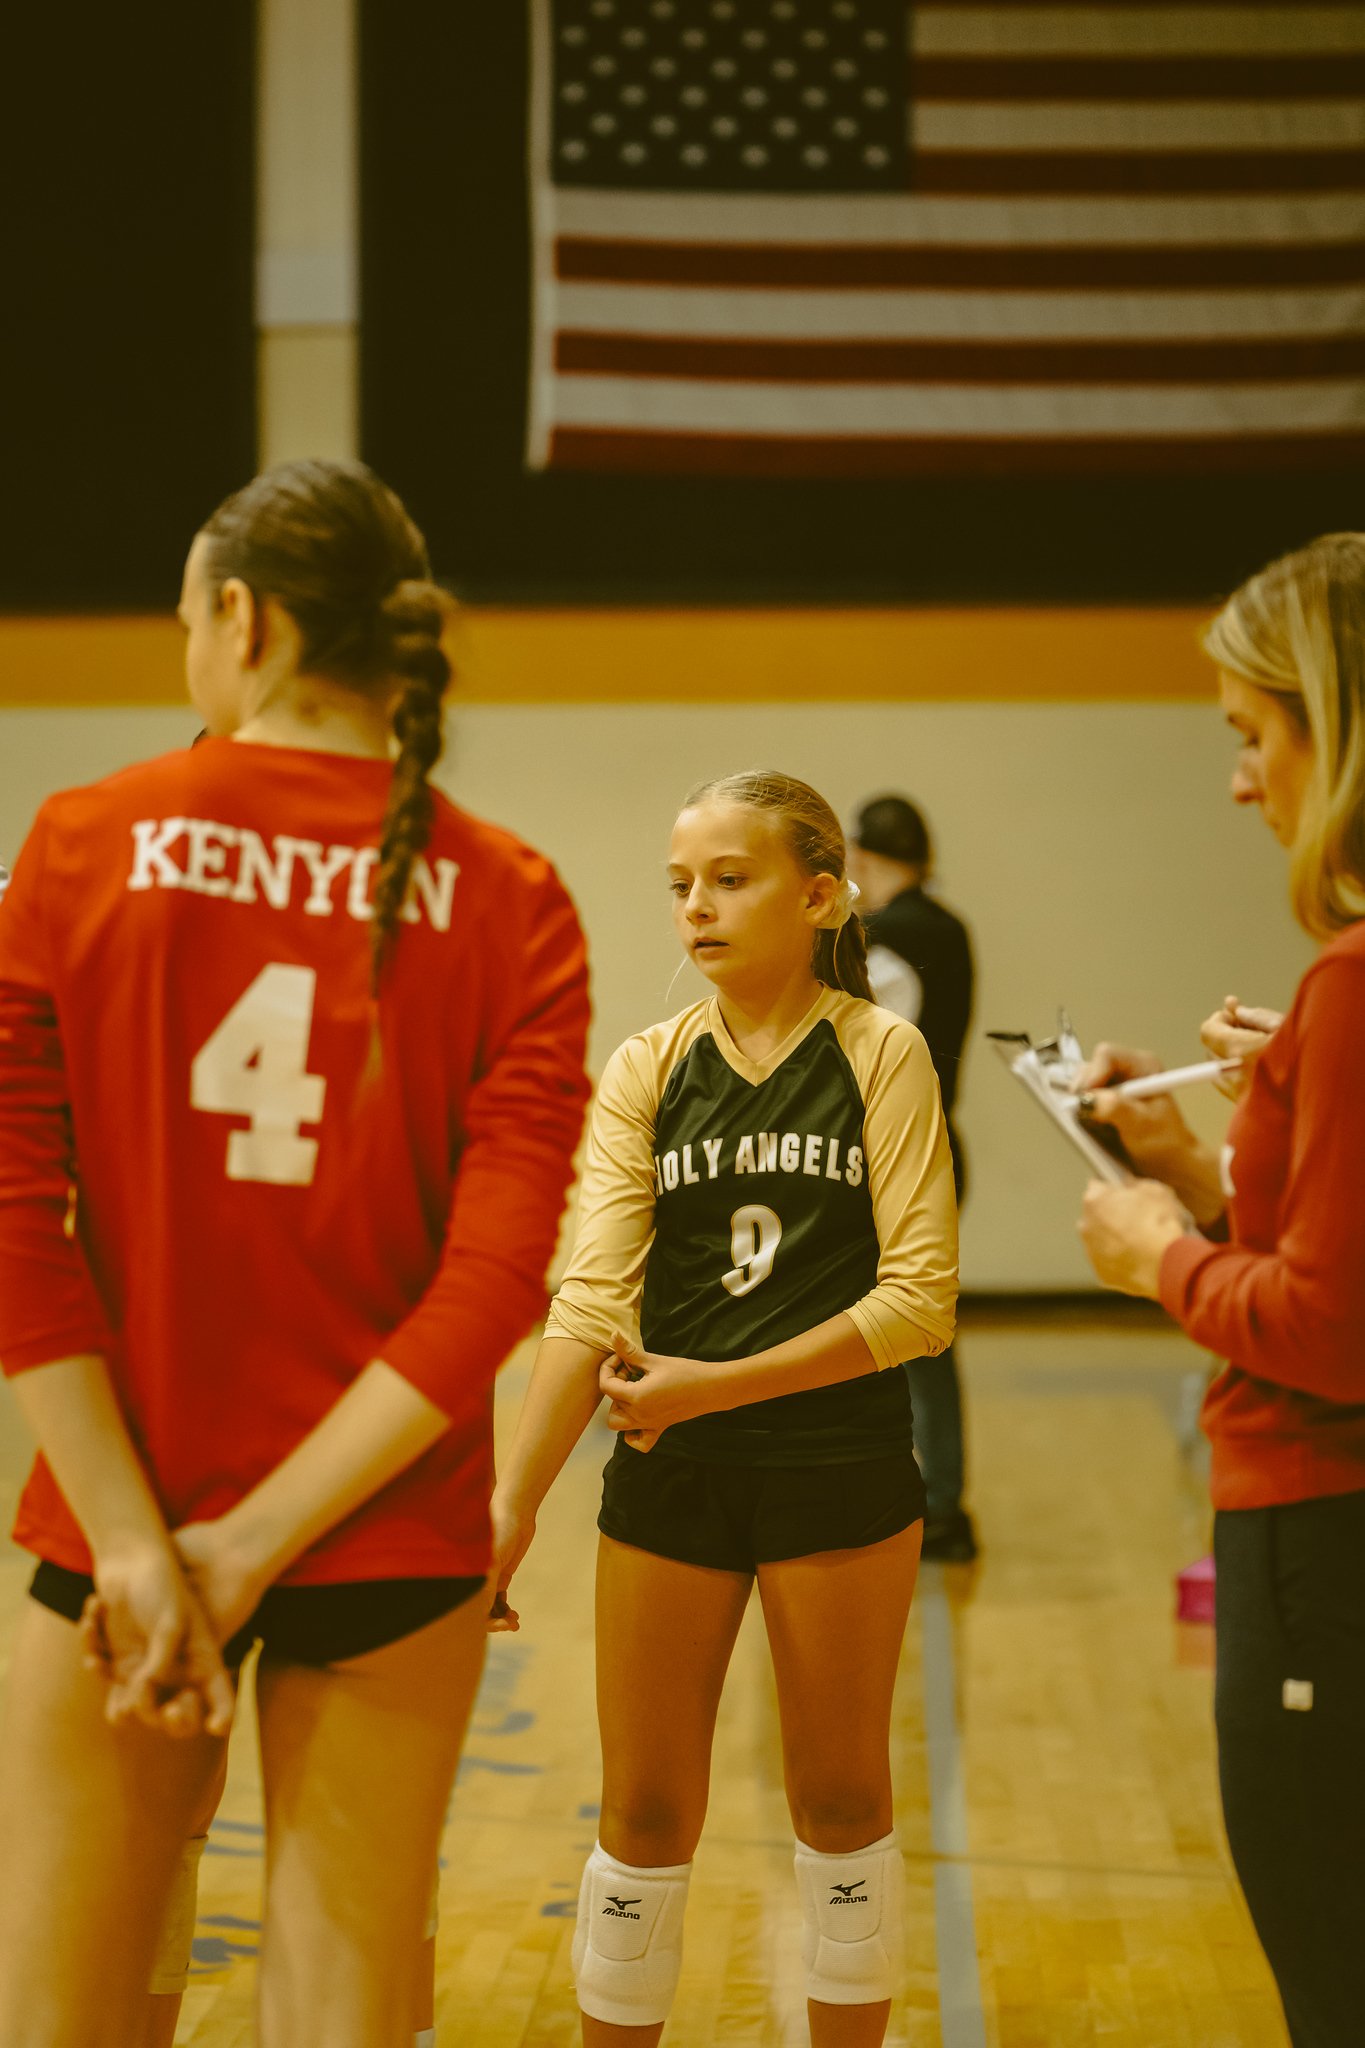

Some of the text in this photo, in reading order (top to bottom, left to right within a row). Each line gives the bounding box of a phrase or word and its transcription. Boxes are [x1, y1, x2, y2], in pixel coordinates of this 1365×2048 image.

[190, 962, 327, 1188] 4
[734, 1132, 864, 1188] ANGELS
[721, 1204, 783, 1297] 9
